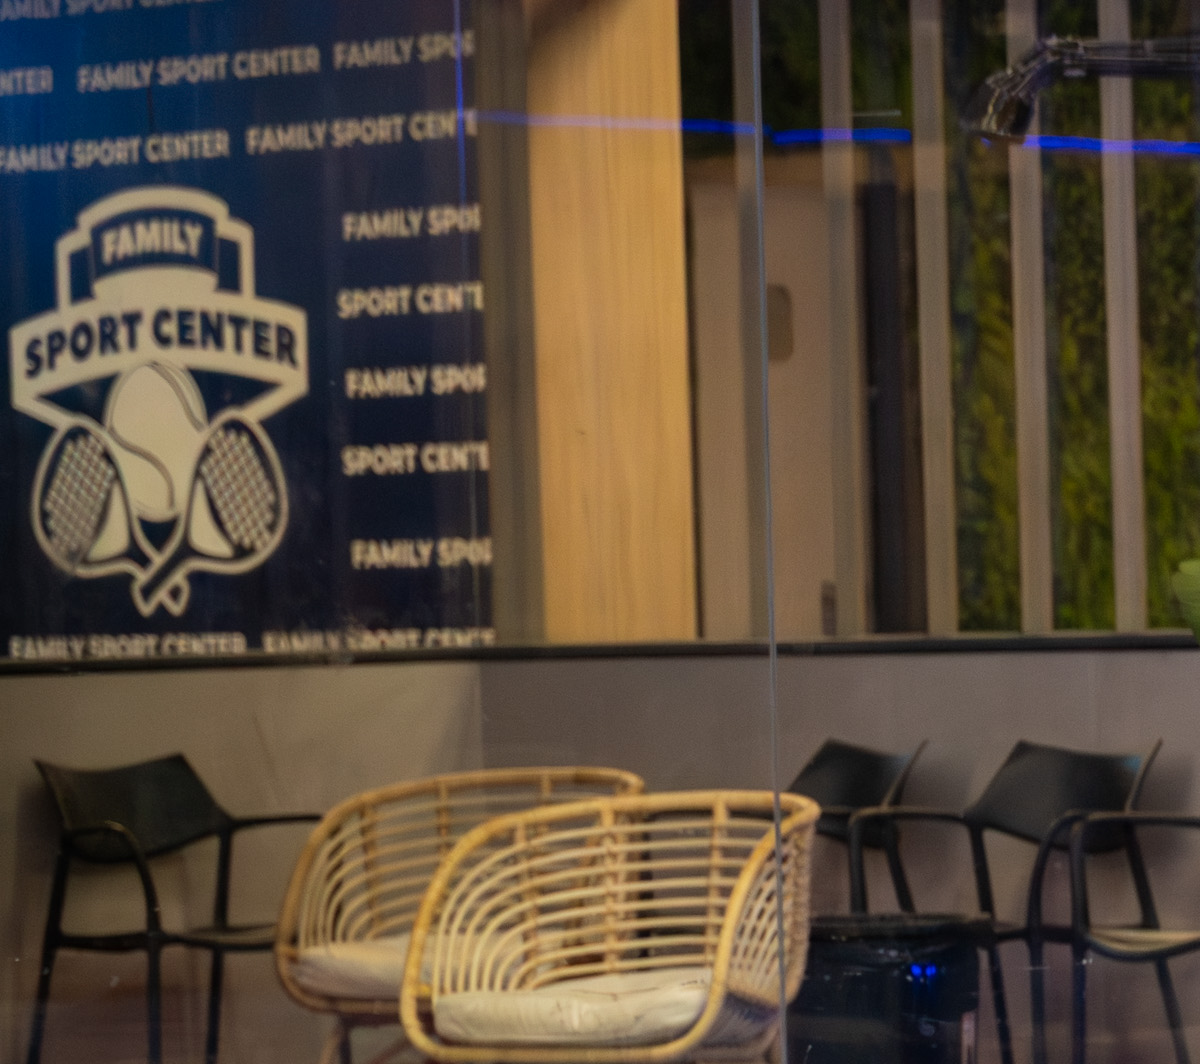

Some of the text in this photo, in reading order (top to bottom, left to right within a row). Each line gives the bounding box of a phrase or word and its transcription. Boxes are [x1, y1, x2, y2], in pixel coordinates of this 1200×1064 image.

[0, 0, 60, 21] AMILY
[77, 45, 321, 94] FAMILY SPORT CENTER
[333, 36, 414, 70] FAMILY
[0, 67, 53, 95] NTER
[72, 135, 141, 169] SPORT
[145, 128, 231, 163] CENTER
[245, 120, 328, 154] FAMILY
[330, 114, 405, 147] SPORT
[101, 217, 203, 264] FAMILY
[342, 206, 424, 241] FAMILY
[337, 284, 413, 320] SPORT
[25, 308, 298, 377] SPORT CENTER
[345, 365, 428, 399] FAMILY
[341, 442, 418, 476] SPORT
[351, 538, 435, 570] FAMILY
